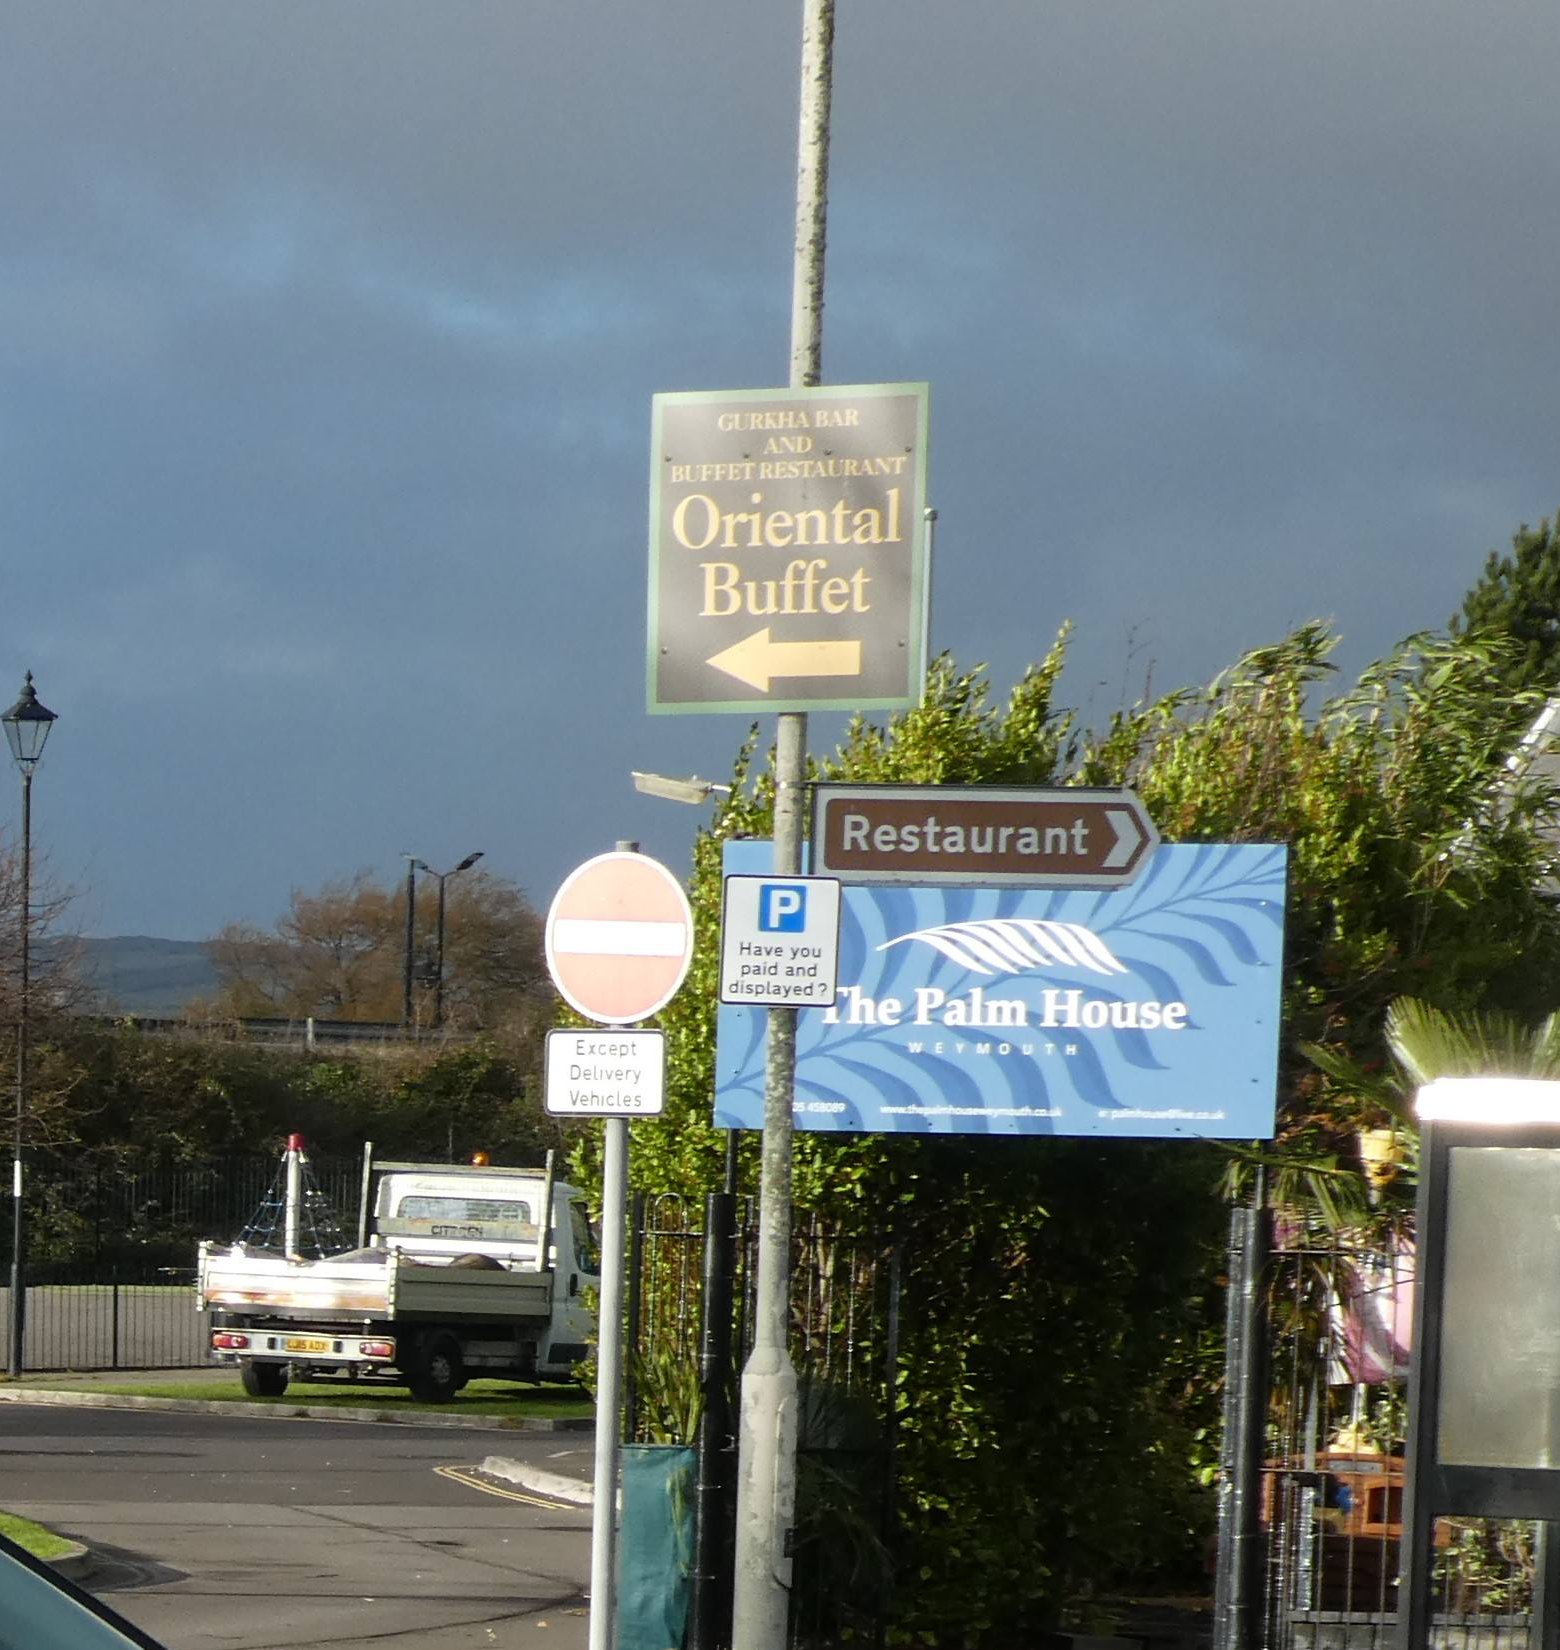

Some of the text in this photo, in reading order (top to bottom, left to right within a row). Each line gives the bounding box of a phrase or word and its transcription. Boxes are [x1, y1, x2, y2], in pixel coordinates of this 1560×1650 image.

[717, 408, 861, 432] GURKHA BAR
[763, 435, 814, 455] AND
[670, 456, 908, 483] BUFFET RESTAURANT
[672, 487, 903, 550] Oriental
[698, 559, 872, 617] Buffet
[842, 812, 1089, 856] Restaurant
[769, 889, 801, 929] P
[739, 942, 822, 961] Have you
[740, 961, 818, 978] paid and
[912, 986, 1028, 1027] Palm
[1039, 989, 1188, 1030] House
[576, 1039, 637, 1058] Except
[908, 1041, 1079, 1057] WEYMOUTH
[570, 1064, 642, 1085] Delivery
[569, 1089, 642, 1108] Vehicles
